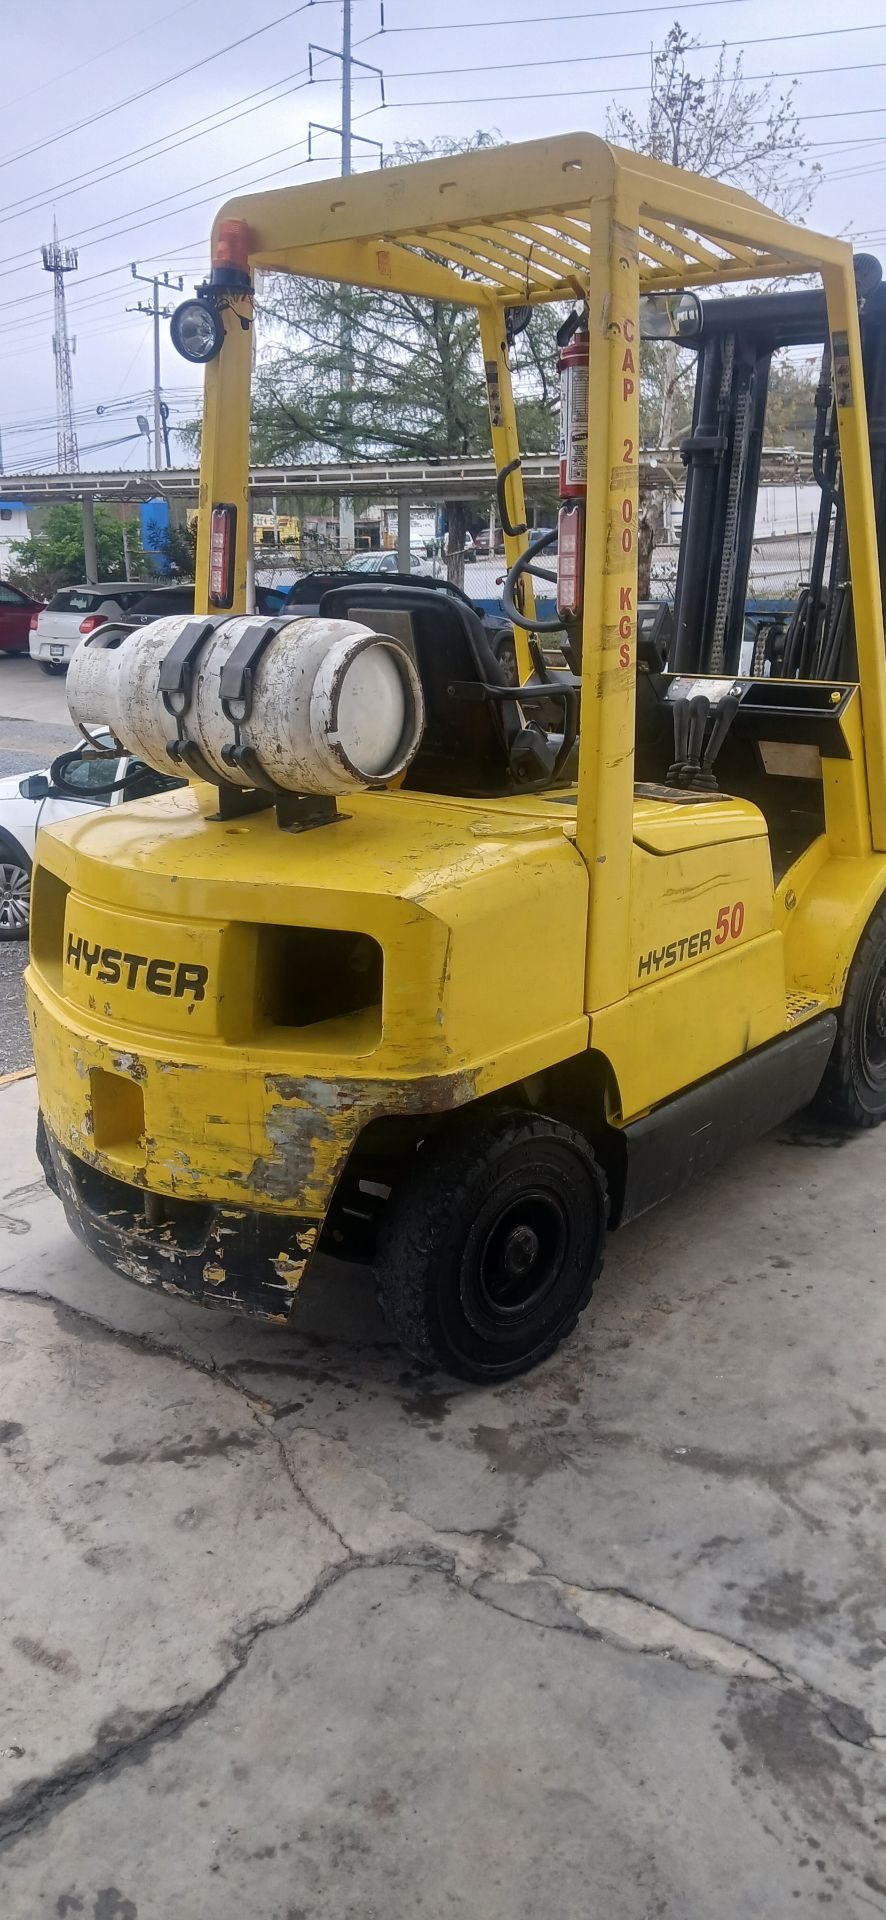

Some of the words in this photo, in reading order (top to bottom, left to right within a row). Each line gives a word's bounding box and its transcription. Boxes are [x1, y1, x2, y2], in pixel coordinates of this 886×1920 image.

[622, 318, 635, 402] CAP
[619, 586, 632, 668] KGS
[66, 932, 209, 1002] HYSTER
[637, 929, 712, 978] HYSTER
[714, 901, 745, 945] 50
